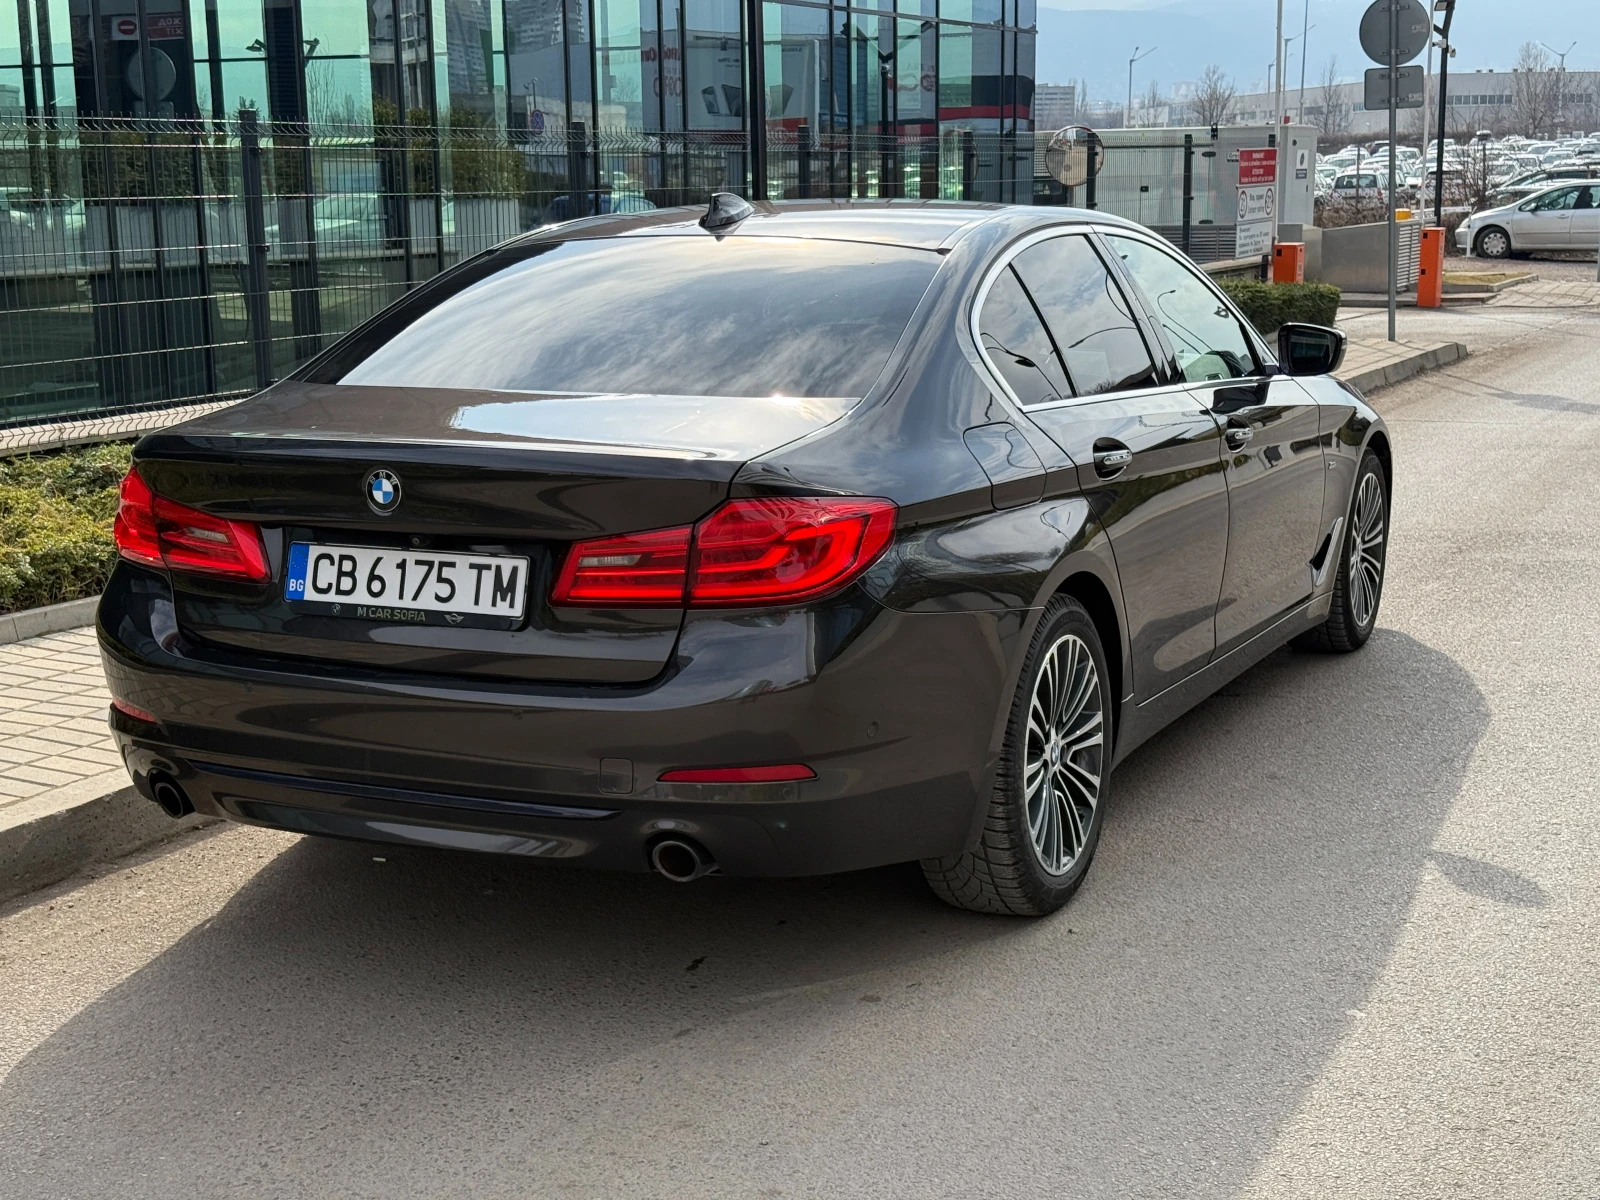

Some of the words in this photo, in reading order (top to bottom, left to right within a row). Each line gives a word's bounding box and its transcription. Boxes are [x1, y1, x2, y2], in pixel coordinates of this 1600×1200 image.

[289, 579, 304, 592] BG
[312, 553, 358, 596] CB
[366, 556, 457, 604] 6175
[469, 562, 519, 609] TM
[357, 606, 367, 617] M
[368, 607, 391, 619] CAR
[393, 609, 426, 622] SOFIA
